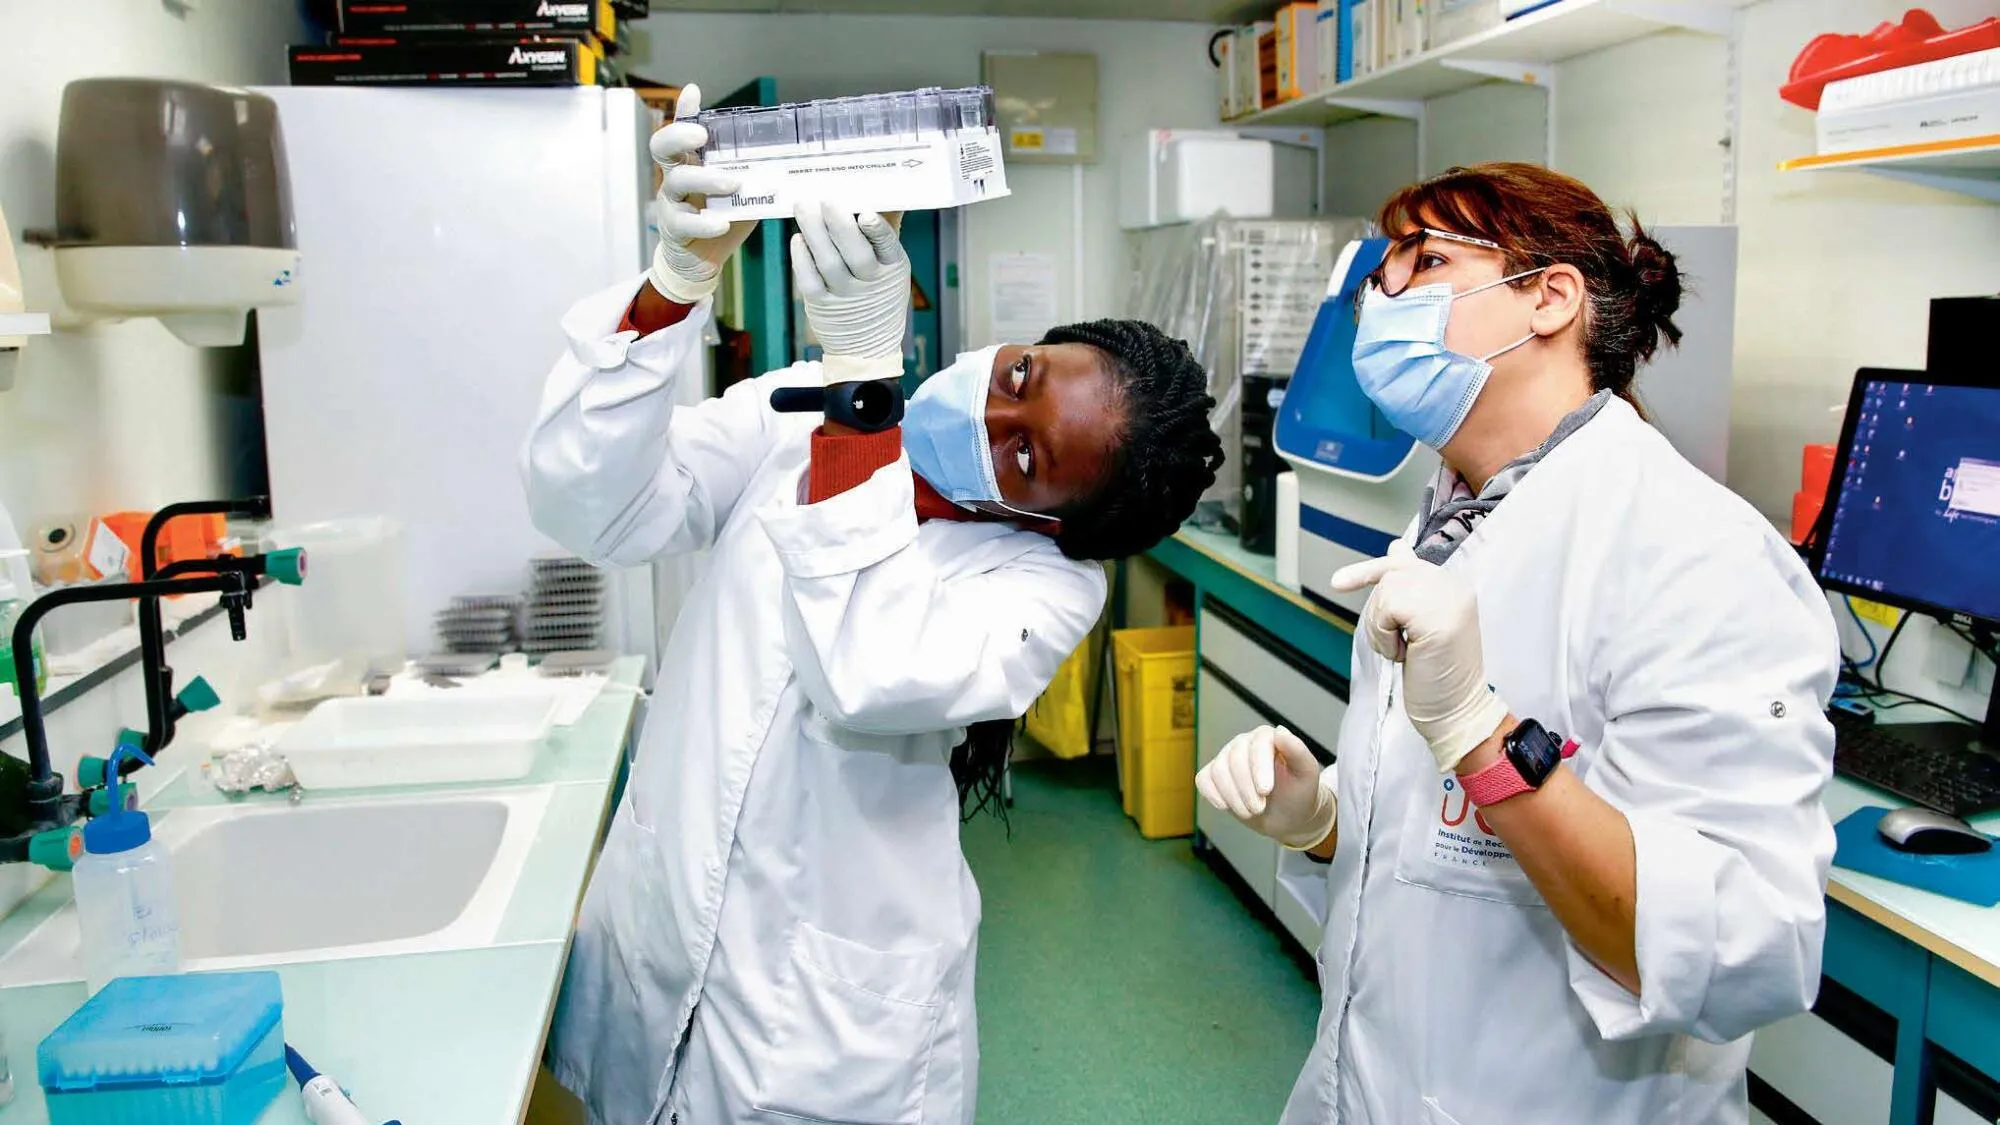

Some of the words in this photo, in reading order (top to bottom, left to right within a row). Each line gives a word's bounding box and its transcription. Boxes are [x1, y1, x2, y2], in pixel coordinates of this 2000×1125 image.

[731, 193, 775, 207] illumina
[1438, 828, 1471, 844] Institut
[1485, 839, 1505, 848] Rec
[1435, 842, 1452, 851] pour
[1461, 845, 1513, 859] Développe
